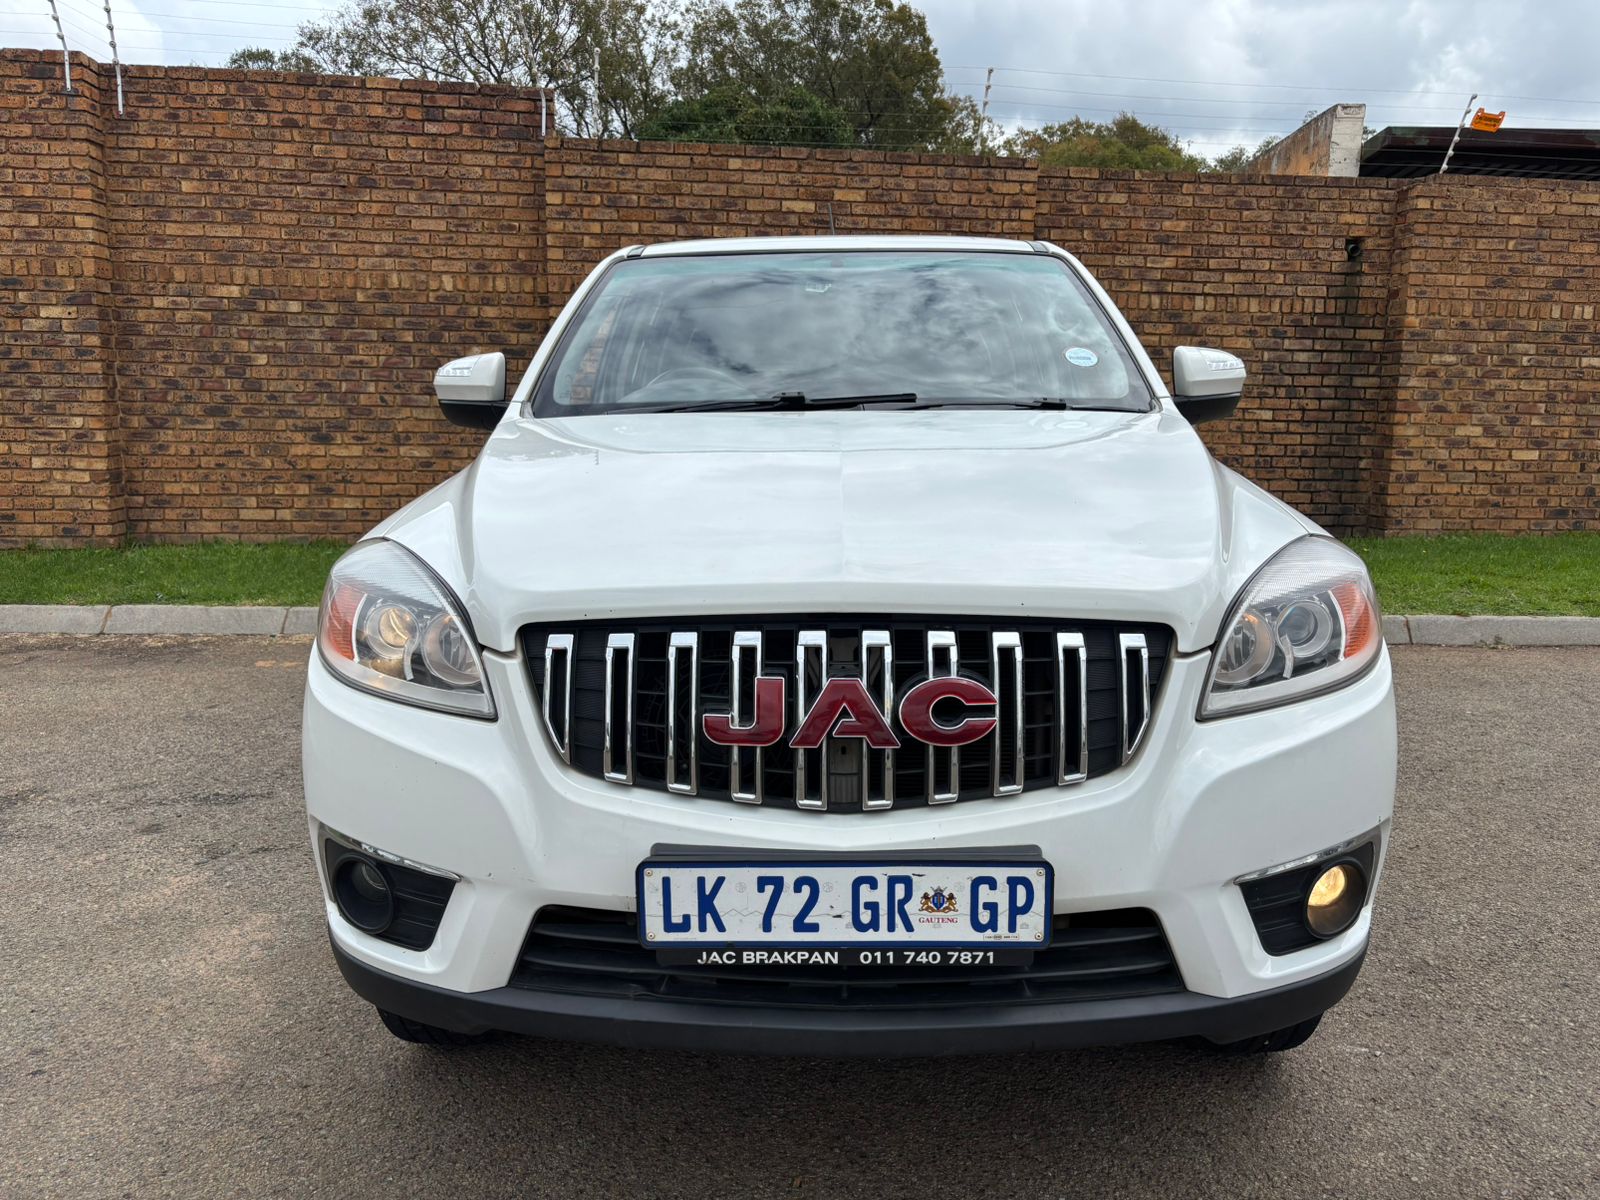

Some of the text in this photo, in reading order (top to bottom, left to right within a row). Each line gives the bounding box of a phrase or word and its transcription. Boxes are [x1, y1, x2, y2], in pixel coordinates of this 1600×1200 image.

[702, 676, 998, 749] JAC
[662, 875, 1035, 934] LK 72 GR GP
[696, 951, 995, 965] JAC BRAKPAN 011 740 7871
